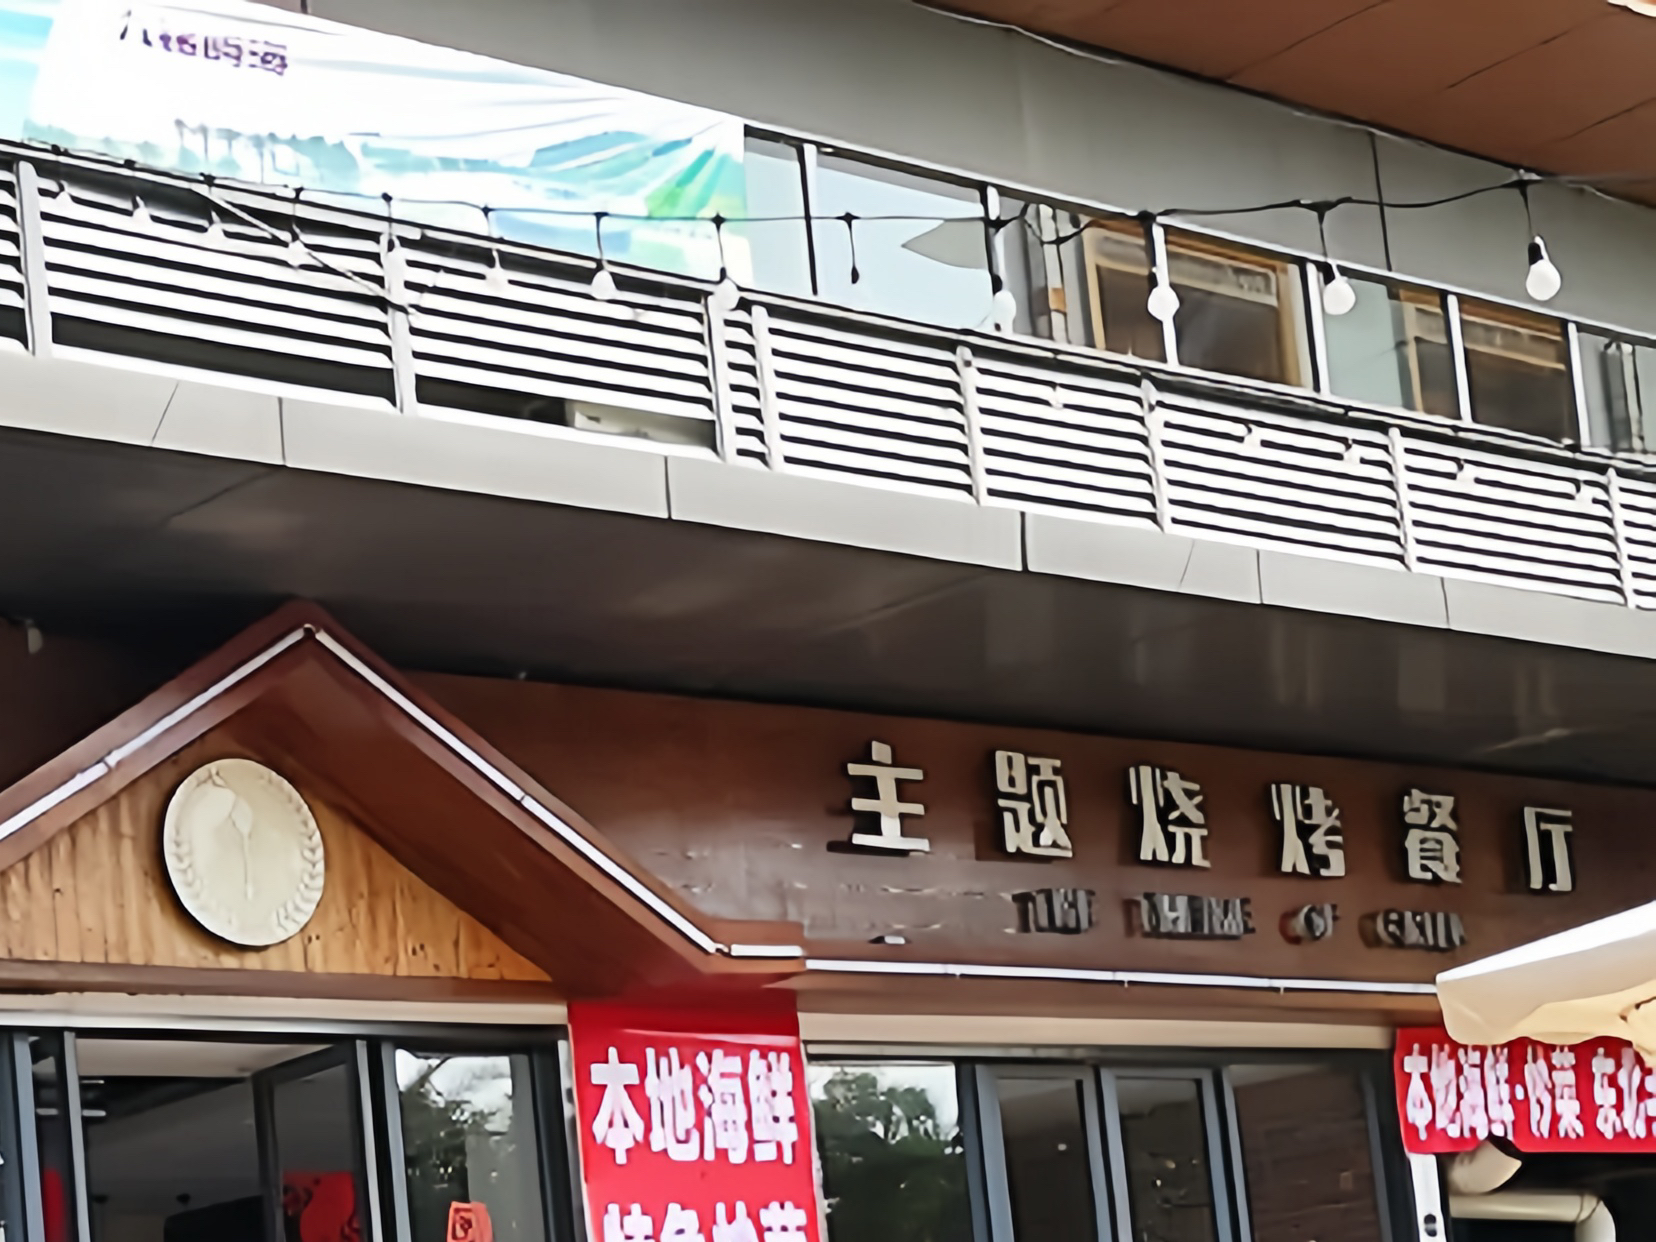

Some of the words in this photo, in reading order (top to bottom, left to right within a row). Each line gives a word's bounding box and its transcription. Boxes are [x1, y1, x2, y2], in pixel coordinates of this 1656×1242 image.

[846, 740, 1574, 893] 主题烧烤餐厅
[589, 1046, 799, 1165] 本地海鲜
